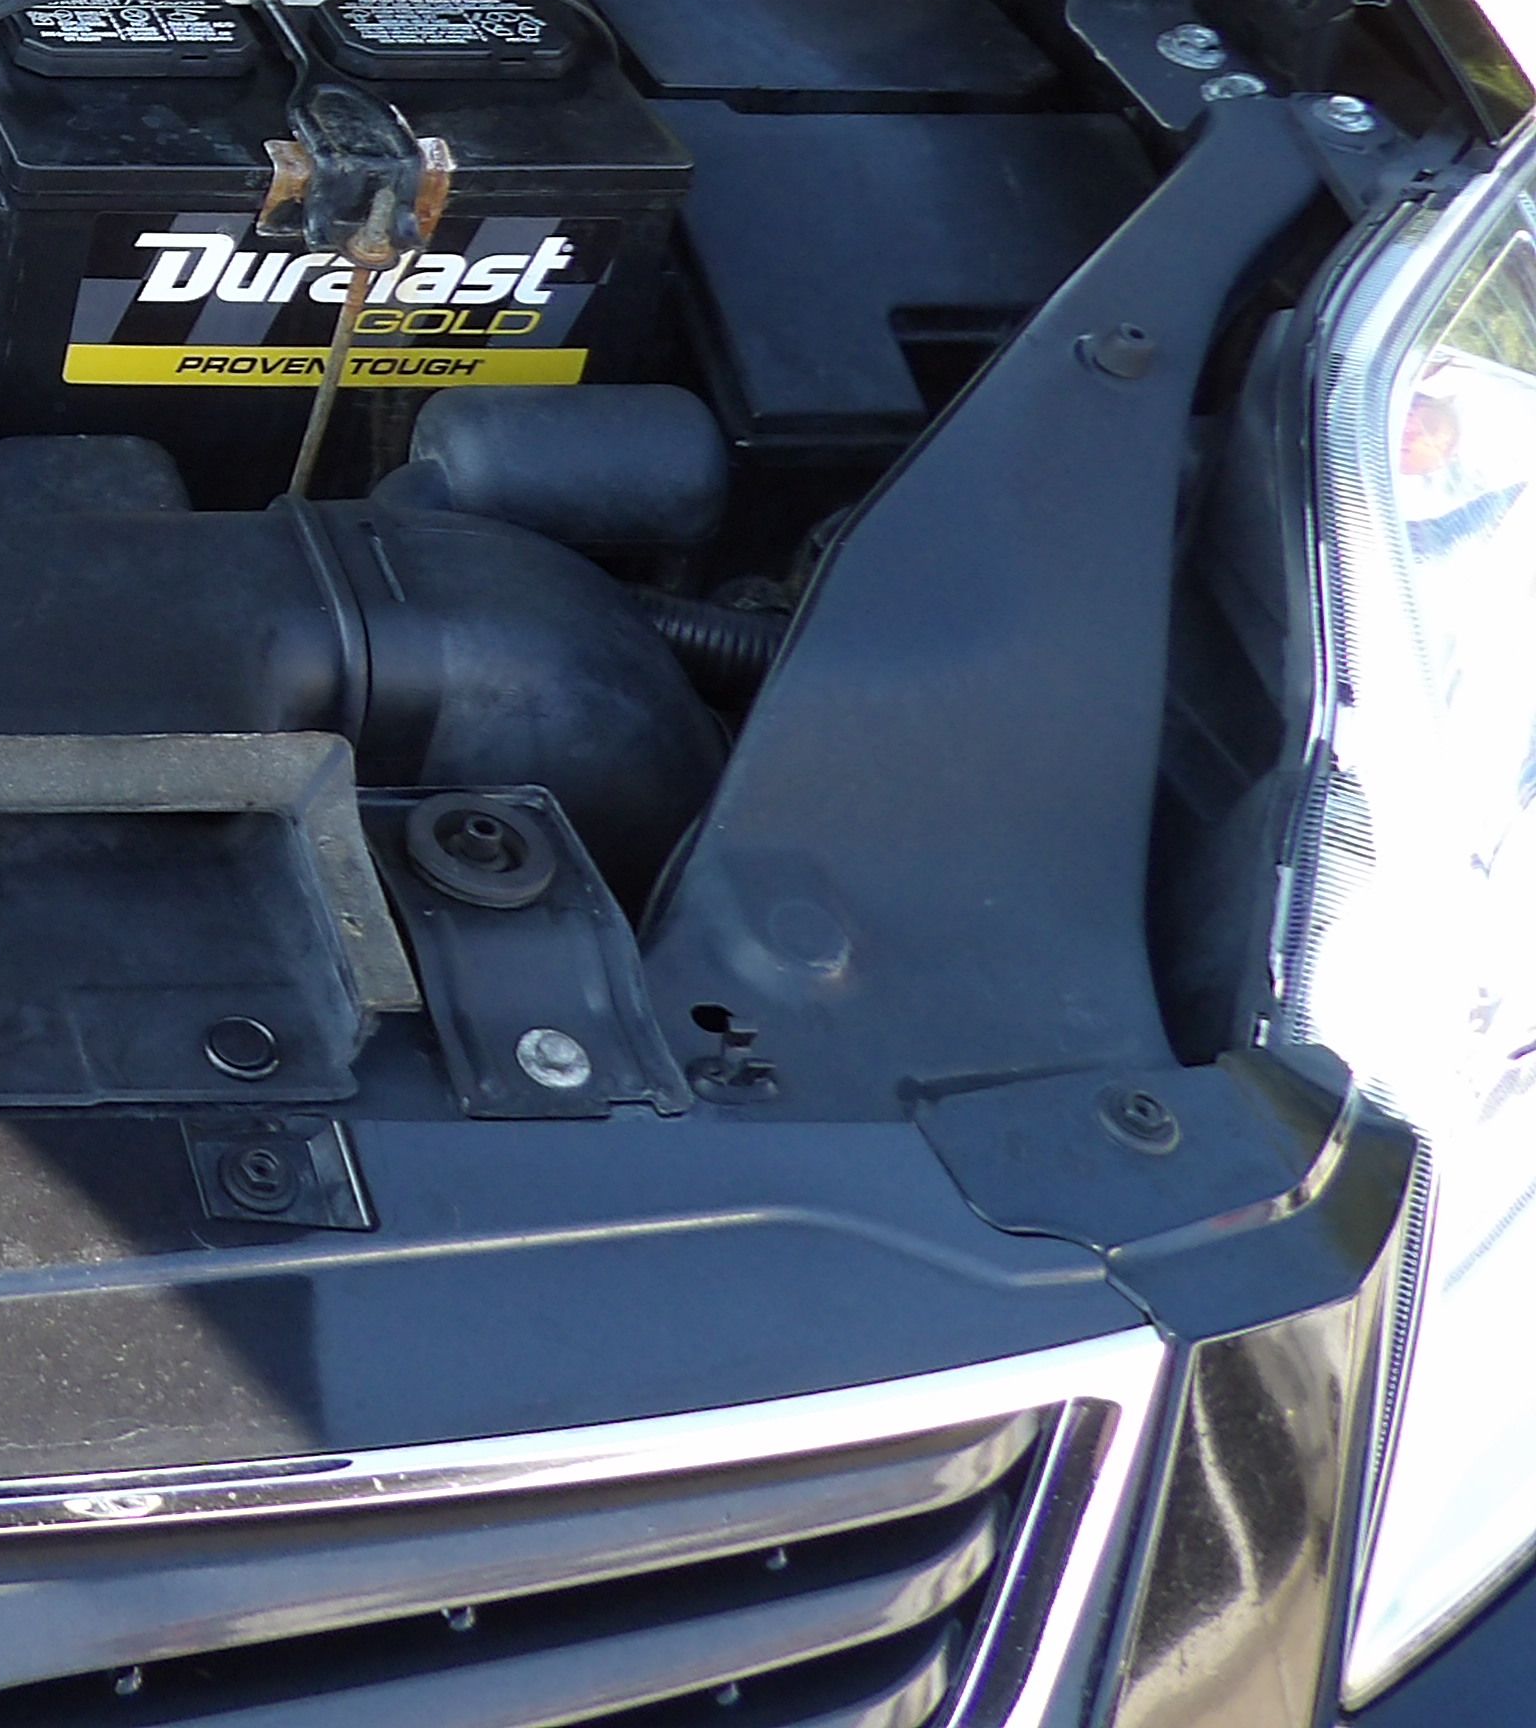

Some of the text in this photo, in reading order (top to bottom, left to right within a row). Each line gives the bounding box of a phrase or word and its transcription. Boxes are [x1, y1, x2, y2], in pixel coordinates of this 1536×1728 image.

[135, 233, 571, 304] Duralast
[352, 309, 542, 336] GOLD
[176, 357, 480, 376] PROVEN TOUGH
